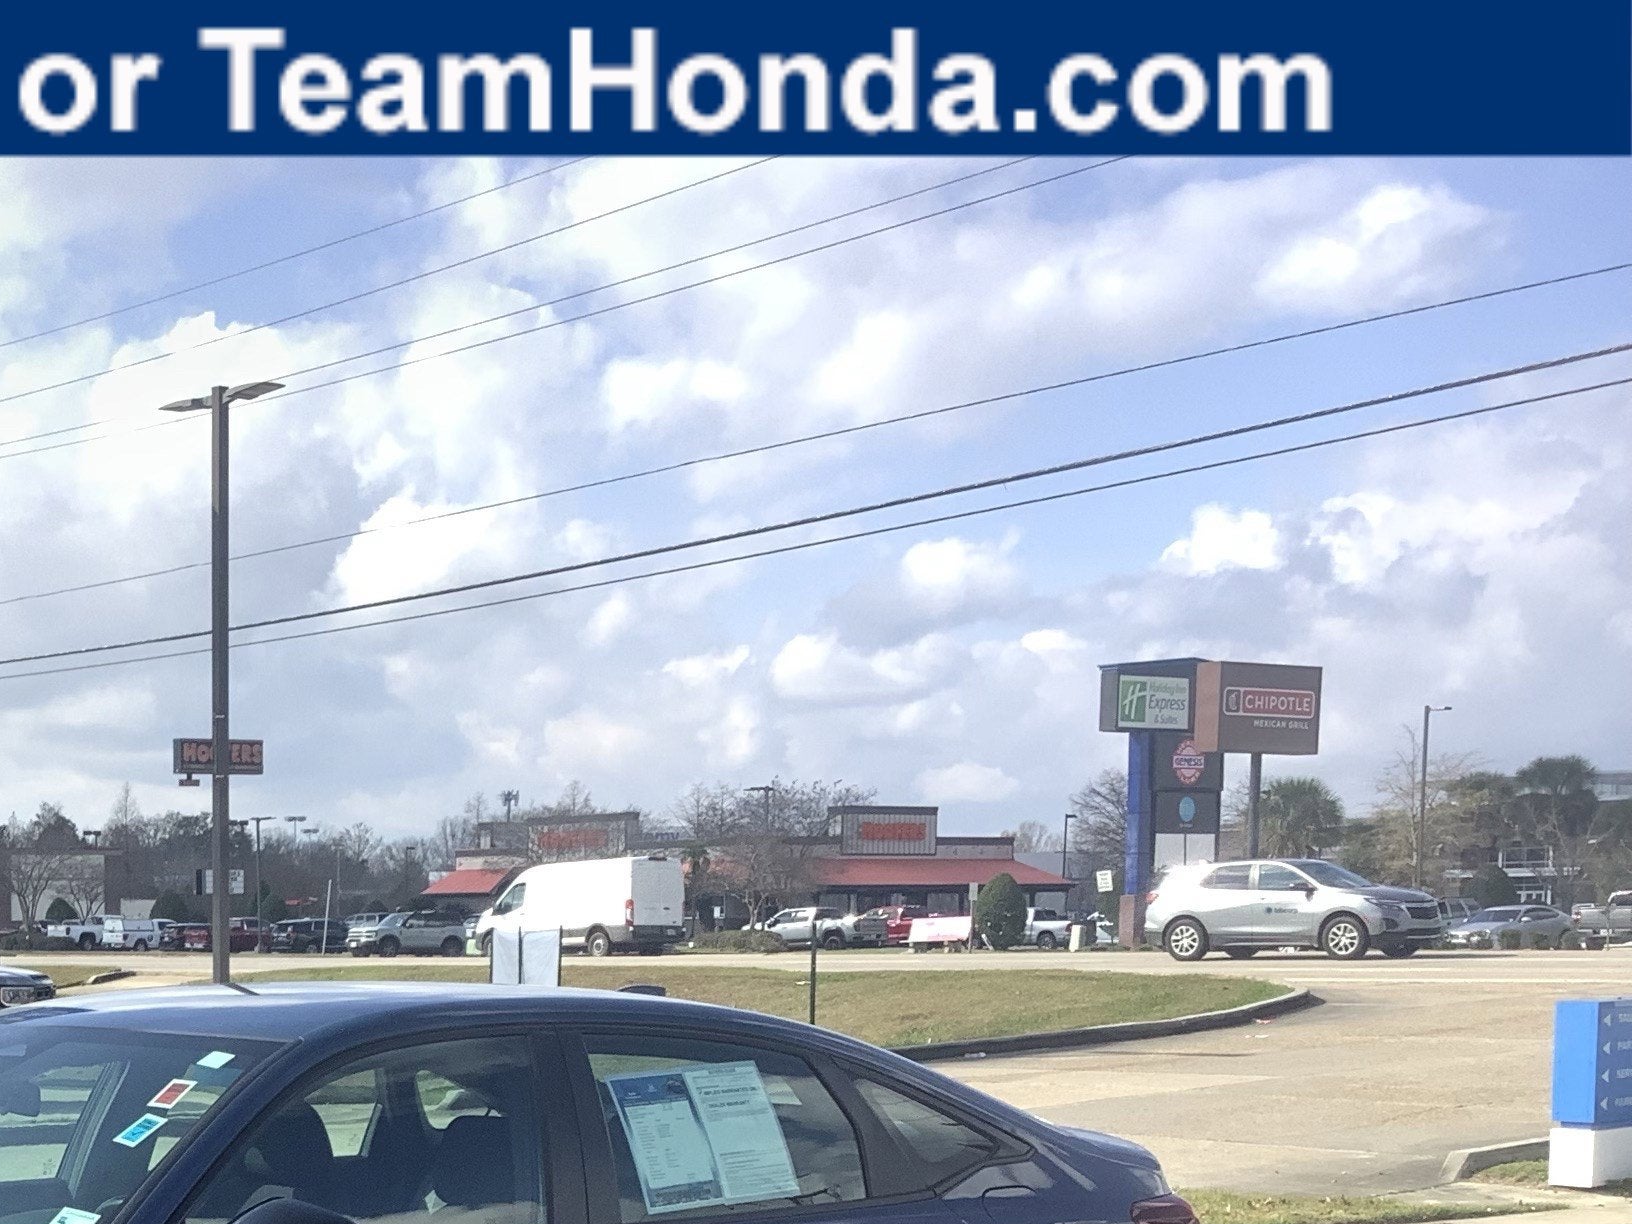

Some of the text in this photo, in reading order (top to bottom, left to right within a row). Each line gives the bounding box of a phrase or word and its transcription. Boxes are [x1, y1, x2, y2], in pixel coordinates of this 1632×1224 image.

[1149, 694, 1186, 712] Express
[1245, 695, 1311, 712] CHIPOTLE
[1253, 720, 1286, 728] MEXICAN
[183, 743, 263, 763] HOERS
